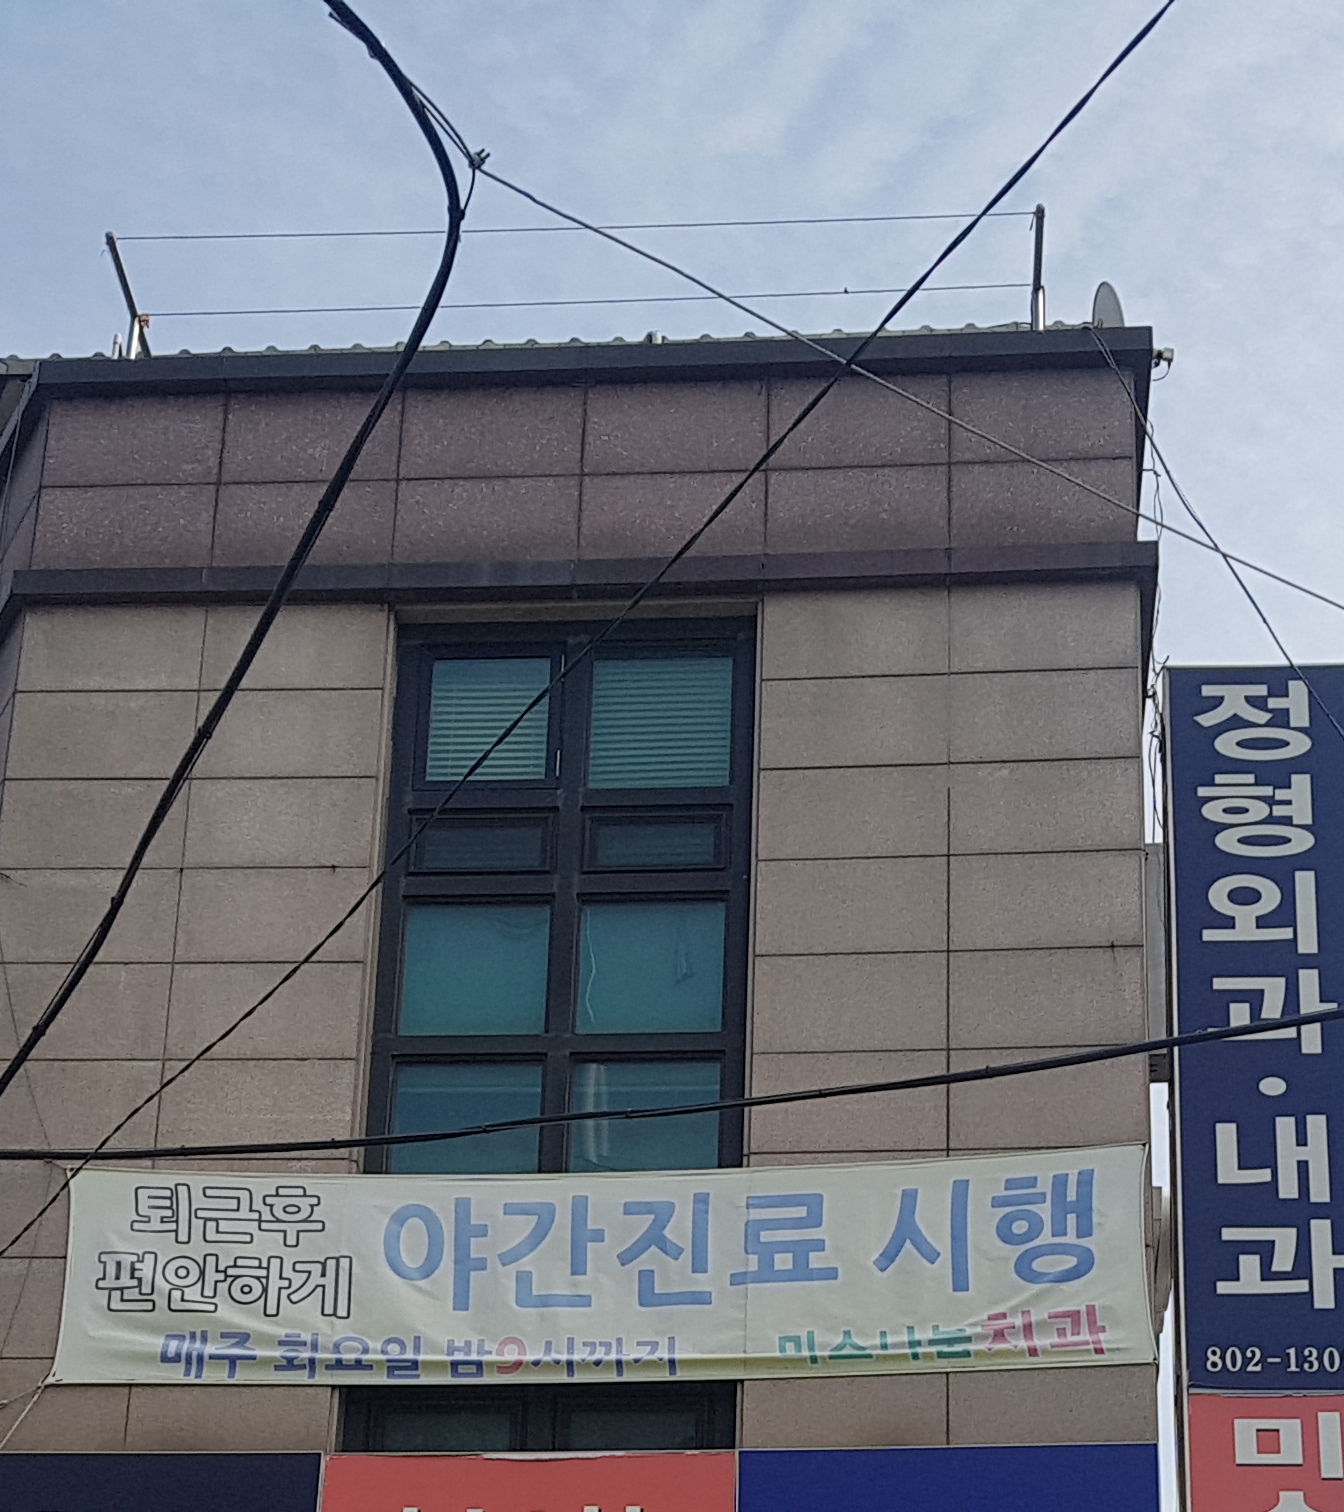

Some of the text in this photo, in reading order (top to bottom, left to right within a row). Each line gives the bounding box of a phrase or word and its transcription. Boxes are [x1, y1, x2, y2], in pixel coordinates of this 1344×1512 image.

[130, 1183, 325, 1247] 퇴근후
[382, 1168, 1096, 1312] 야간진료 시행
[96, 1251, 353, 1319] 편안하게
[159, 1329, 258, 1380] 매주
